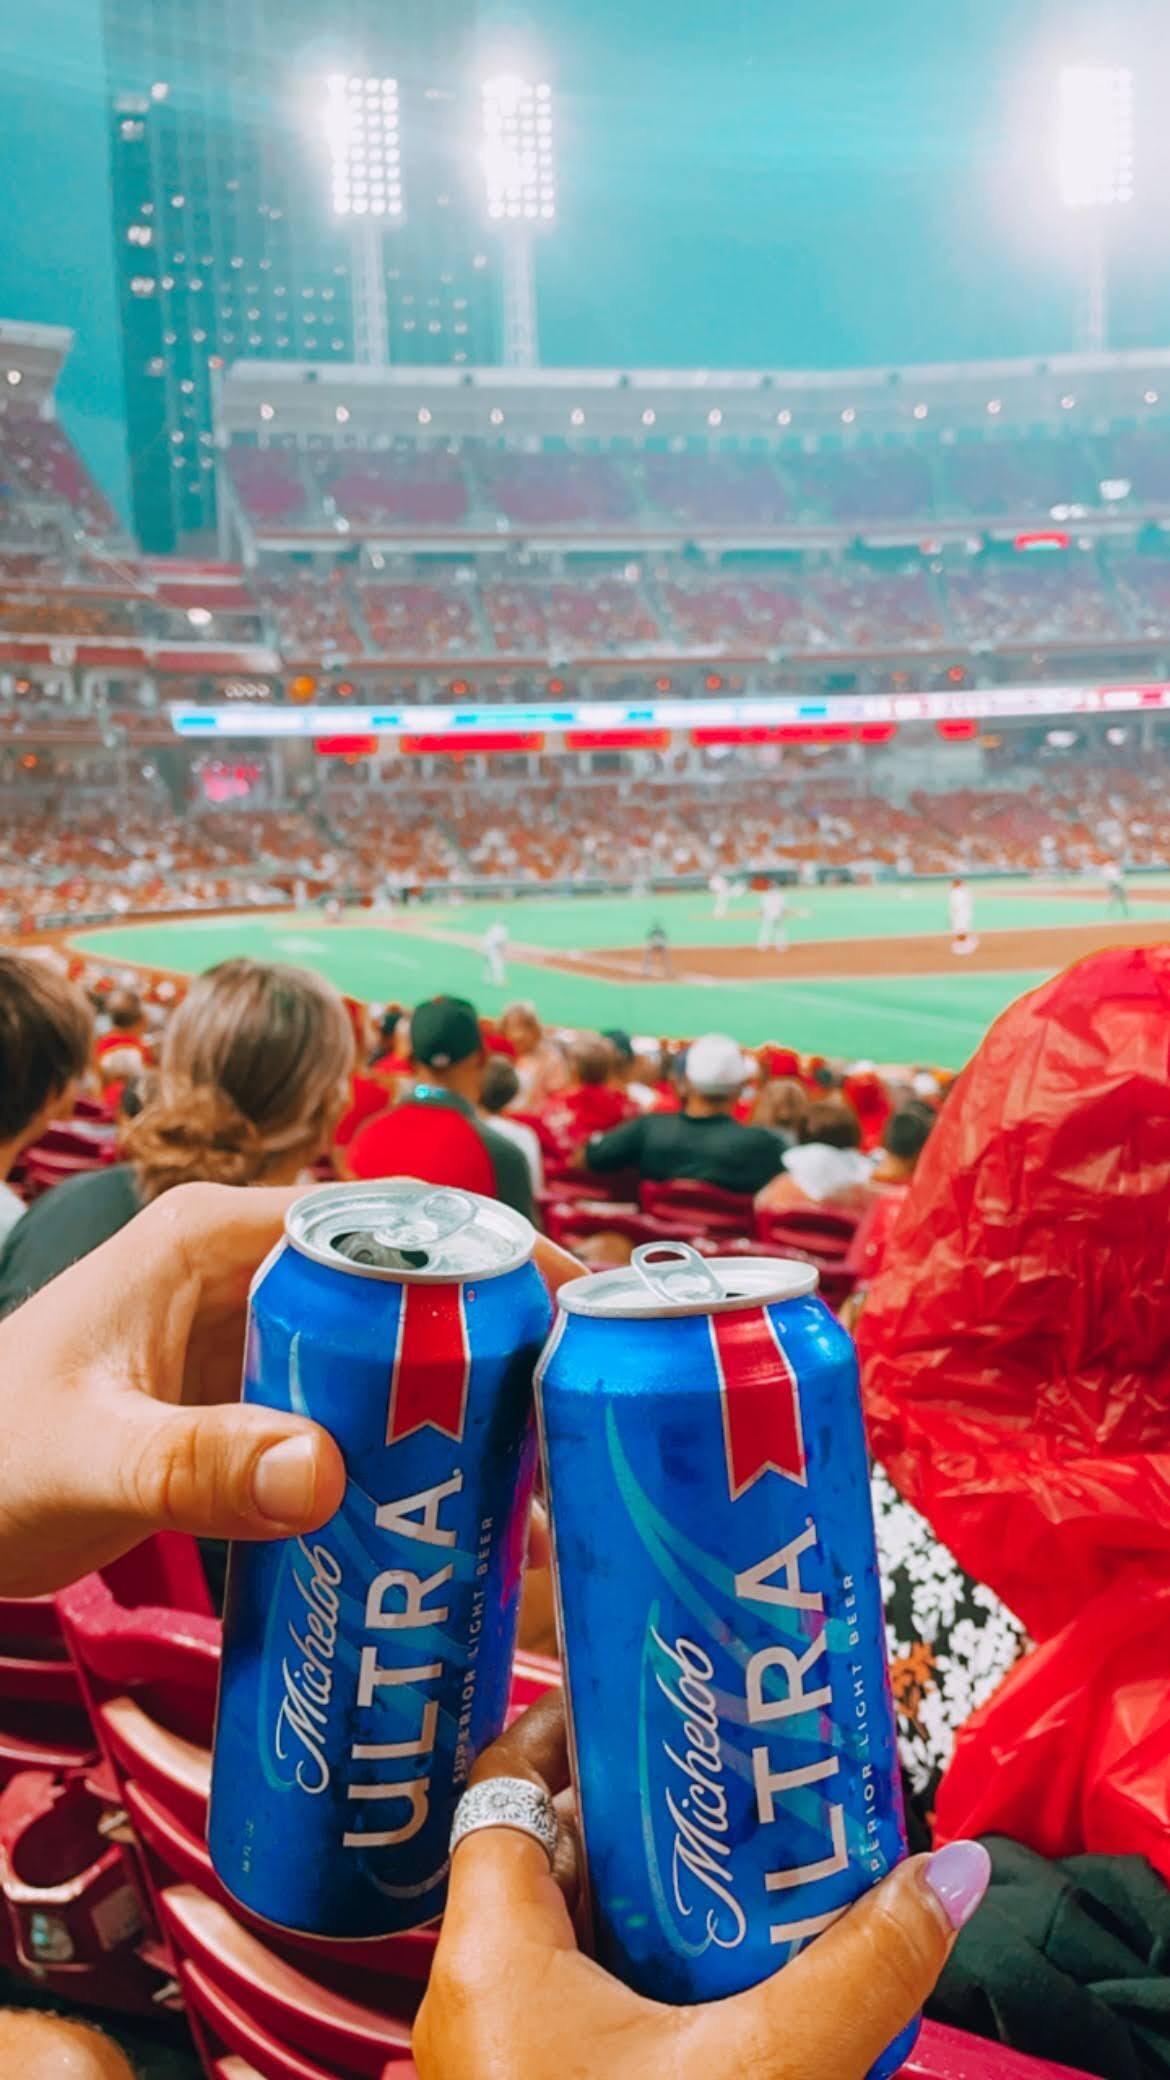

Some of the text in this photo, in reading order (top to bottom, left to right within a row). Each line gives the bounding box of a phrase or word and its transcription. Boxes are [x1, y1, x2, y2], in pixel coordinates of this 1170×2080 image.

[276, 1535, 343, 1794] Michelob
[343, 1472, 462, 1847] ULTRA
[453, 1516, 495, 1785] SUPERIOR LIGHT BEER
[651, 1624, 747, 1948] Michelob
[843, 1573, 881, 1885] PERIOR LIGHT BEER
